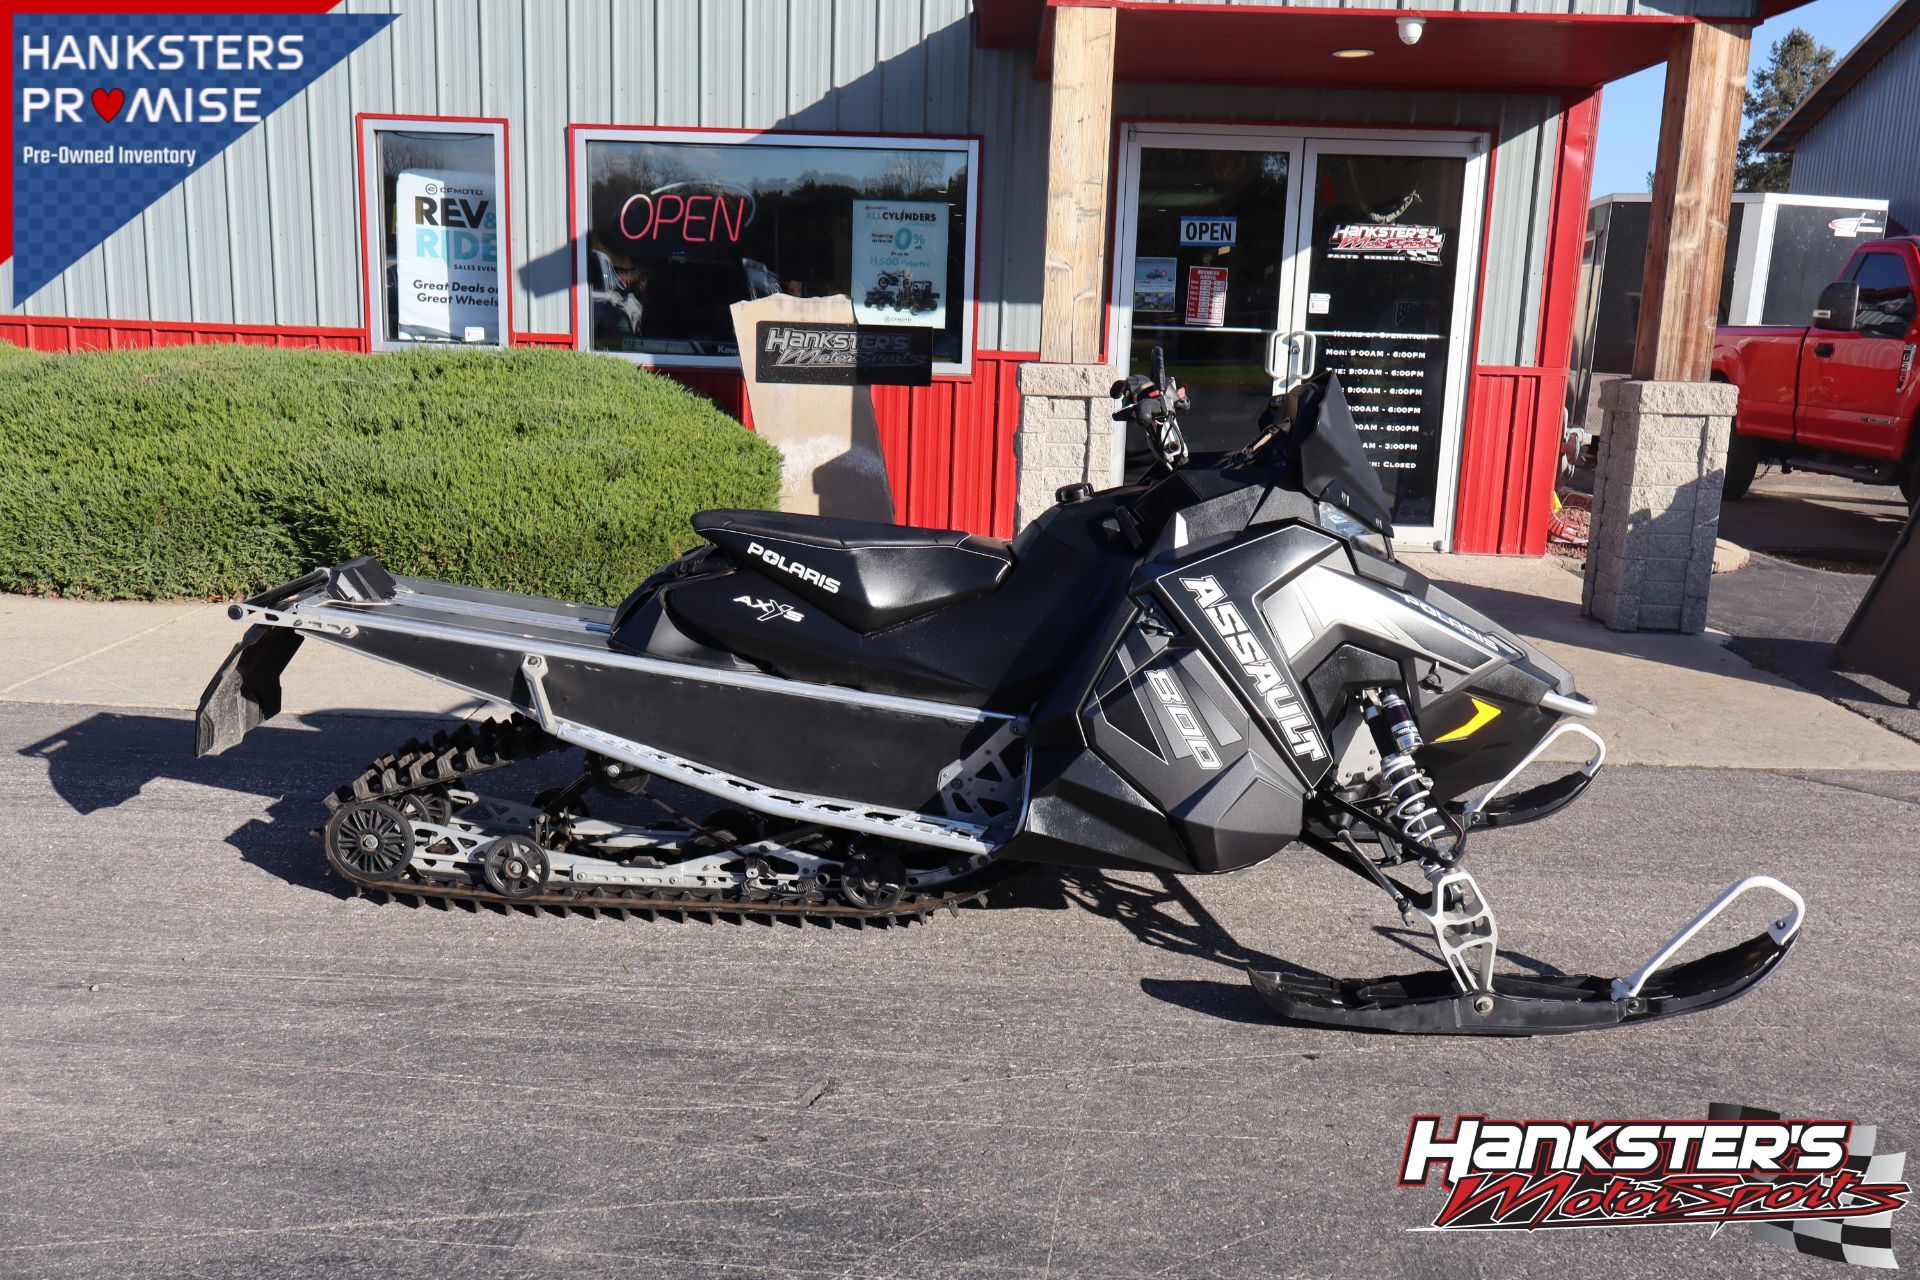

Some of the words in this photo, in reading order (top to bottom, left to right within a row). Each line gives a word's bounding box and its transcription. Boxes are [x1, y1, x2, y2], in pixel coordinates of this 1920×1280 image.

[440, 187, 483, 196] CFMOTO
[415, 196, 489, 229] REV
[620, 193, 745, 243] OPEN
[1186, 222, 1232, 241] OPEN
[416, 228, 497, 263] RIDE
[413, 279, 449, 291] Great
[452, 282, 485, 293] Deals
[417, 292, 453, 304] Great
[456, 295, 498, 307] Wheels
[1392, 351, 1426, 359] 6:00PM
[1348, 368, 1383, 376] 9:00AM
[1391, 369, 1424, 377] 6:00PM
[1389, 388, 1423, 396] 6:00PM
[1387, 406, 1421, 414] 6:00PM
[1386, 424, 1420, 432] 6:00PM
[1384, 442, 1418, 450] 3:00PM
[747, 543, 841, 594] POLARIS
[733, 594, 805, 621] AXYS
[1402, 593, 1499, 653] POLARIS
[1180, 575, 1328, 761] ASSAULT
[1145, 669, 1223, 770] 800
